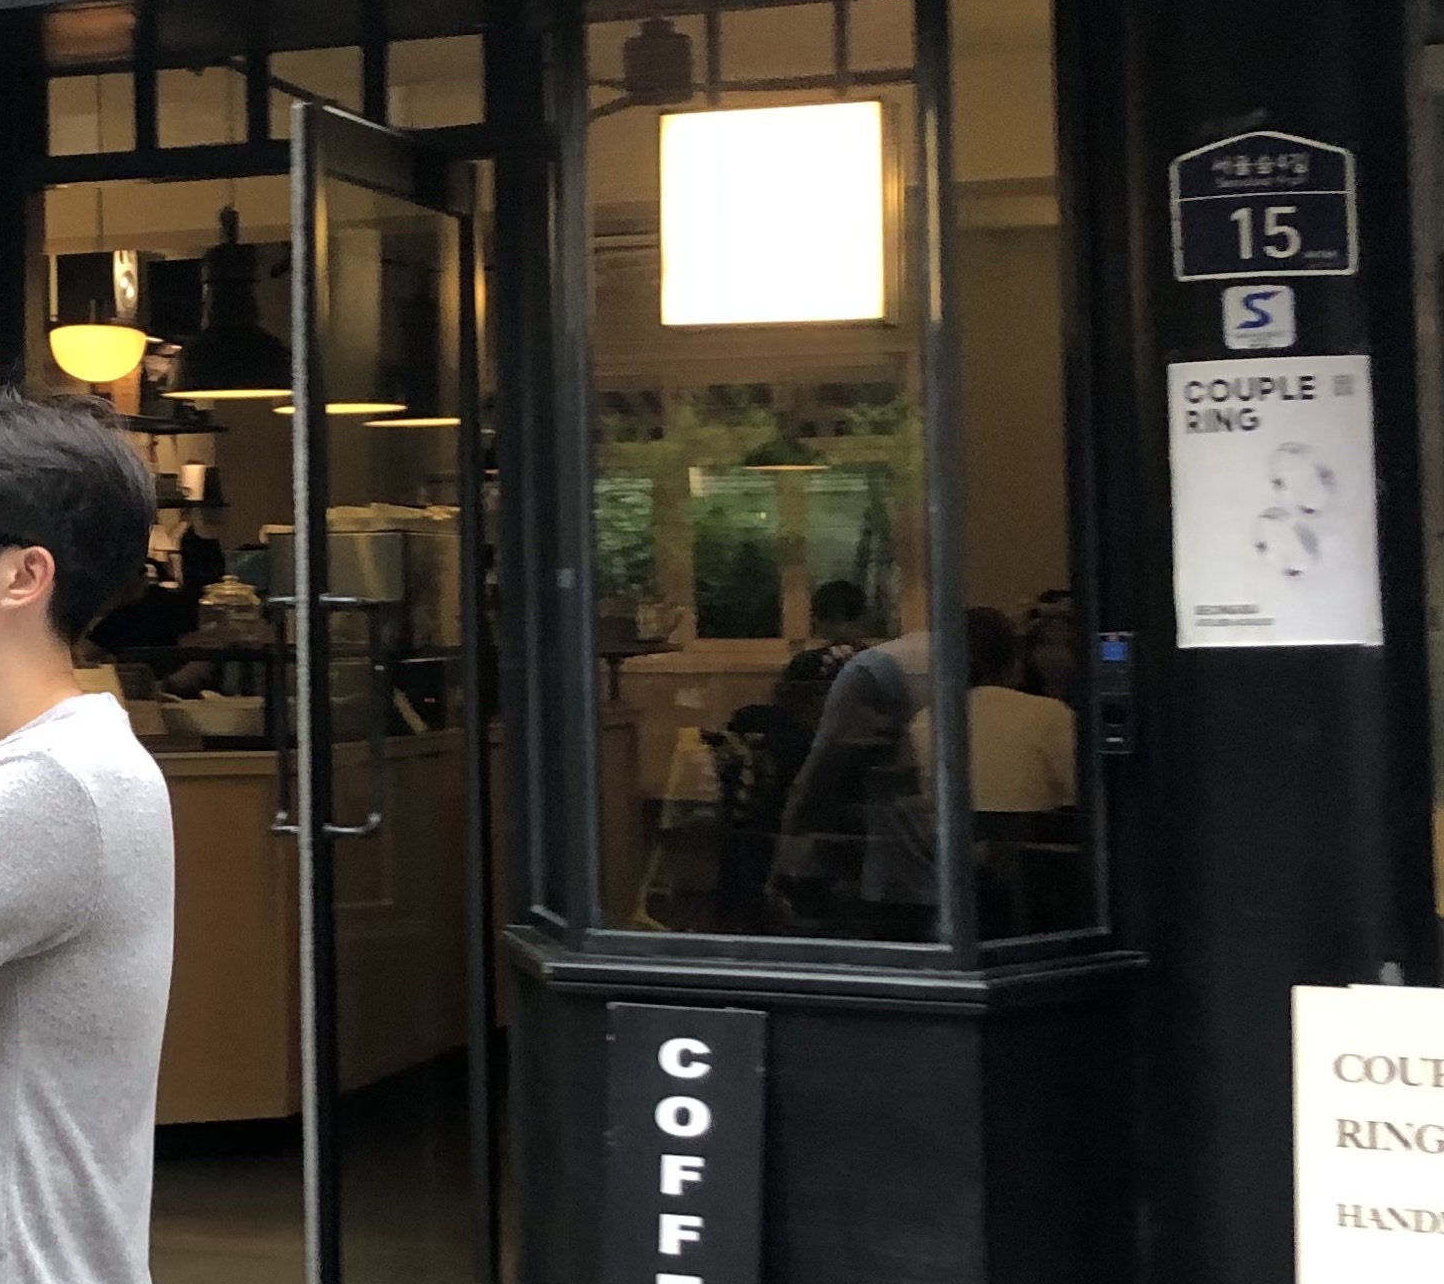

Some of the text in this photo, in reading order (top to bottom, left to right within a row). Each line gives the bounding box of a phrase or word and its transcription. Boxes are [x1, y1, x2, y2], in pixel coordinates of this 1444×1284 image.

[1229, 206, 1302, 260] 15
[1184, 374, 1316, 404] COUPLE
[1185, 407, 1261, 434] RING
[1337, 1203, 1444, 1234] HAND
